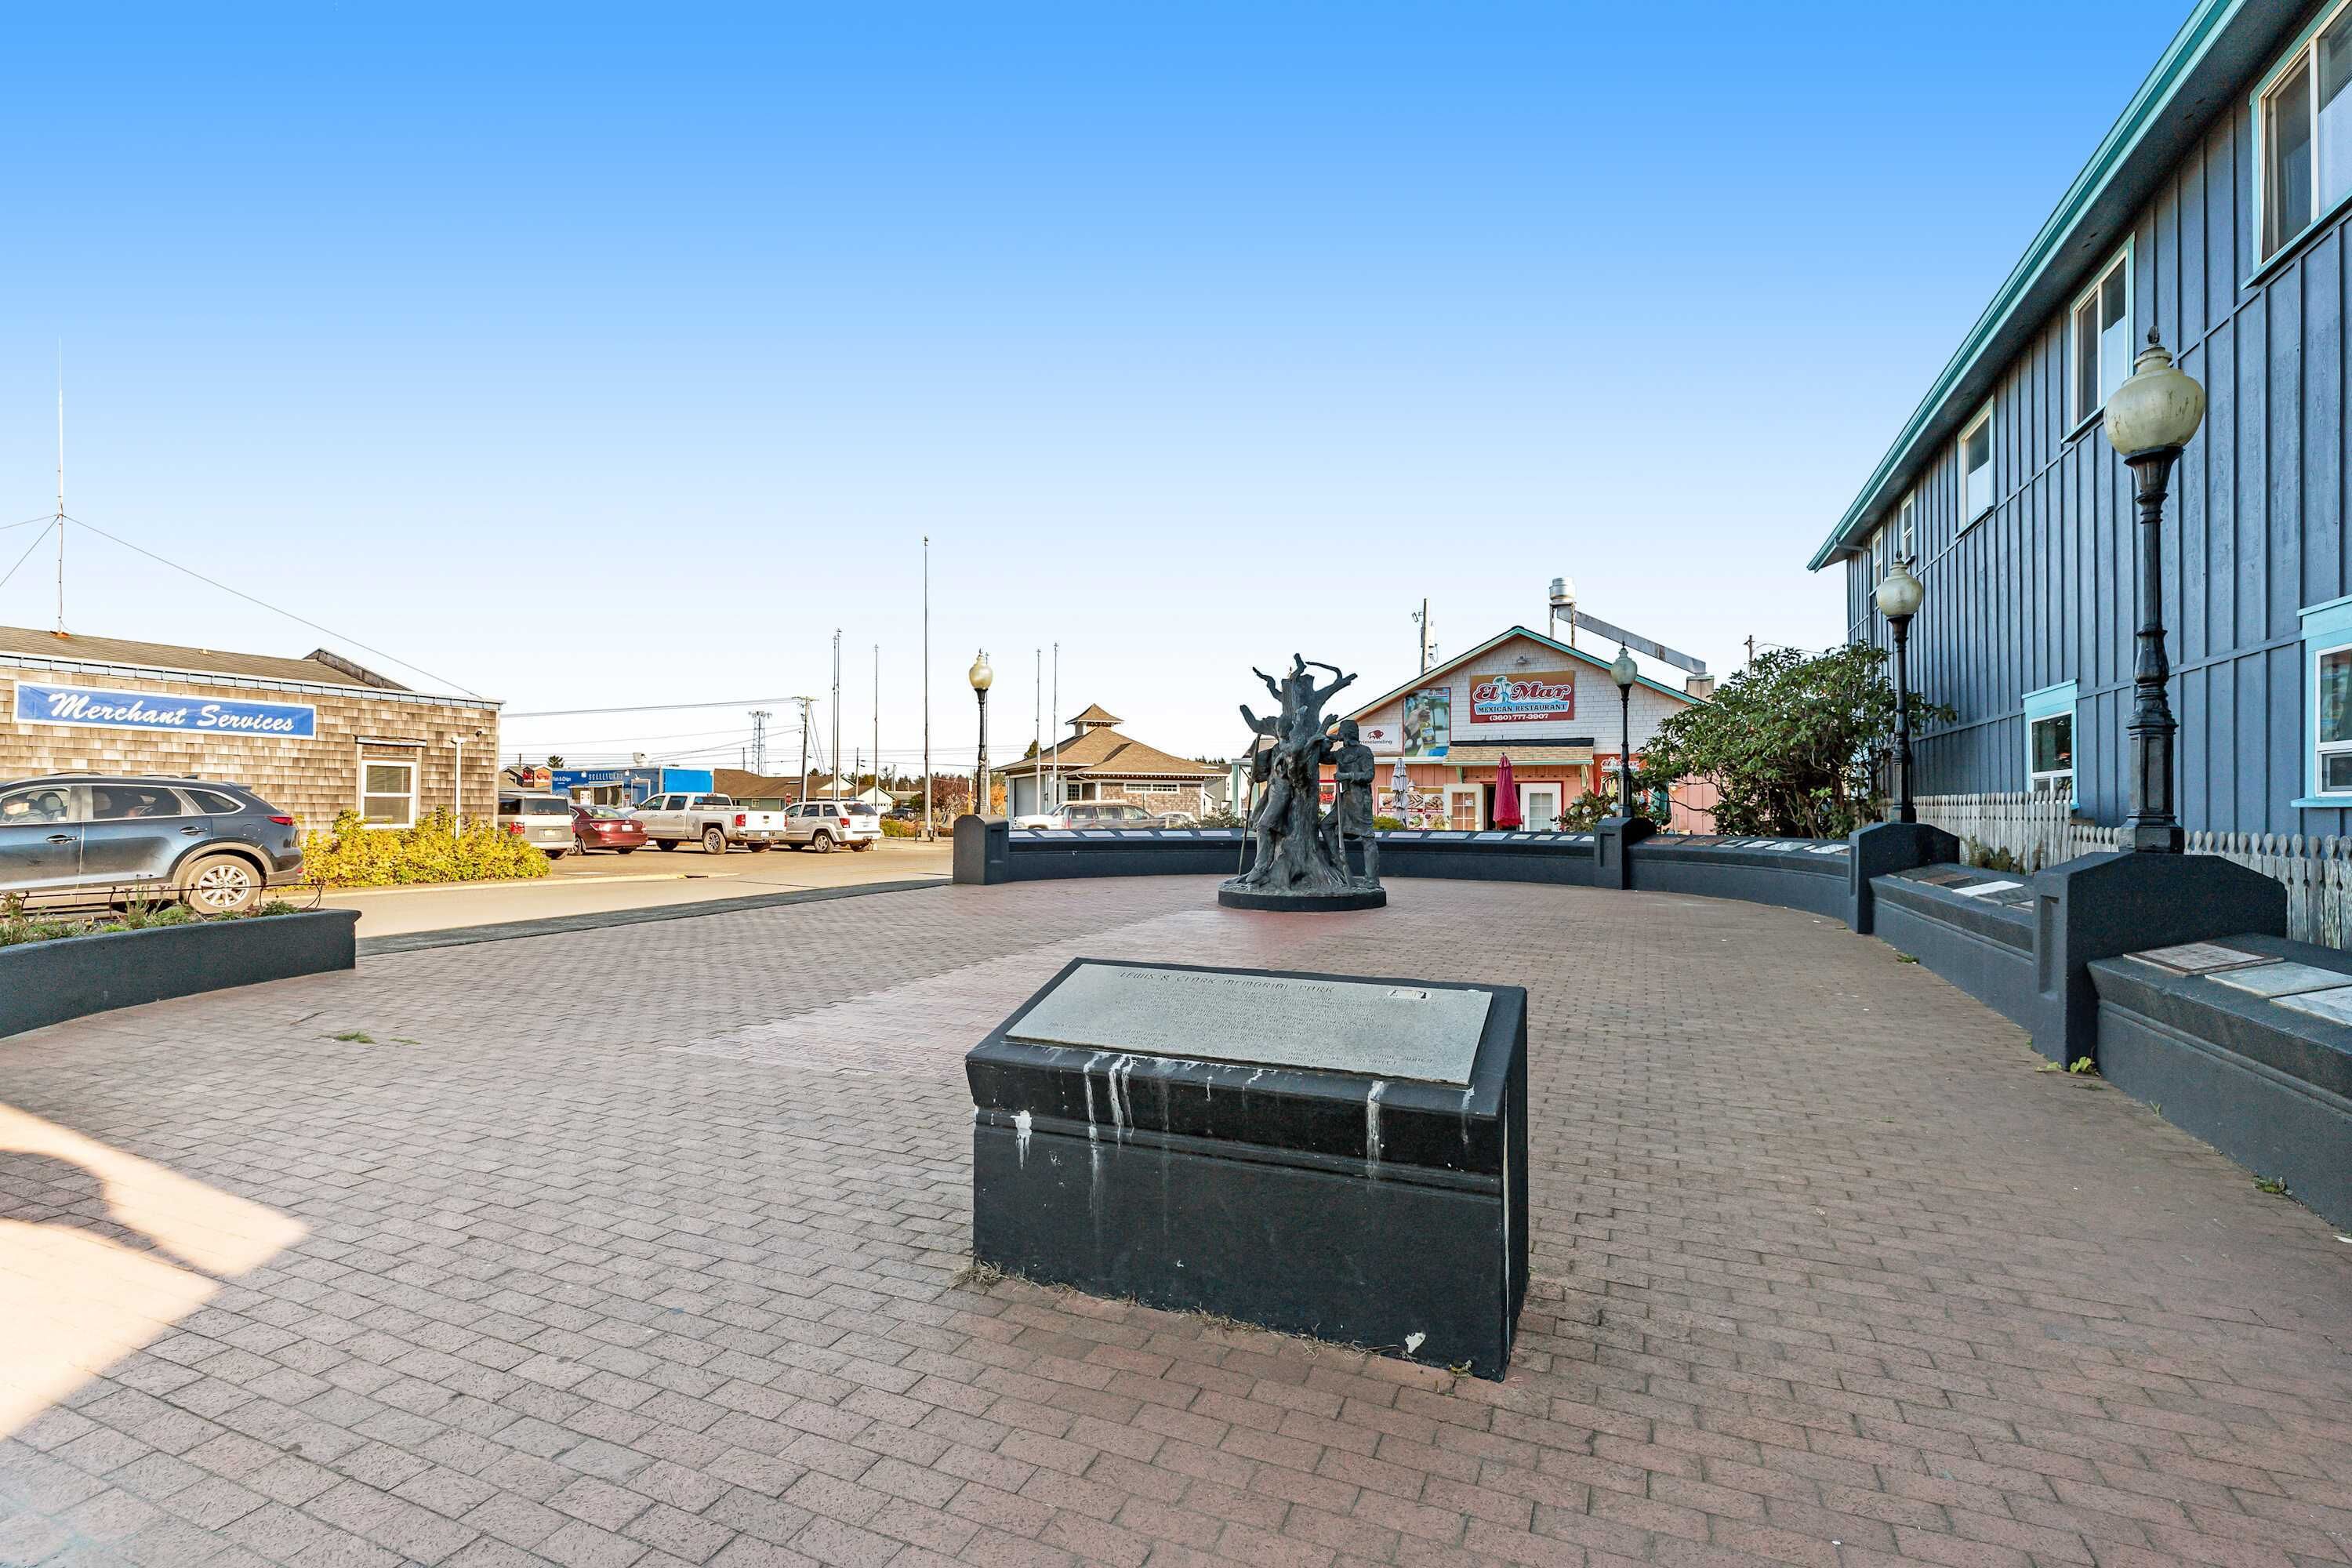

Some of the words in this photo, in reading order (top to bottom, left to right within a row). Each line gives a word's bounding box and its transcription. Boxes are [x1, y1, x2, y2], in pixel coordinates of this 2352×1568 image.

[1475, 684, 1498, 702] El
[1511, 682, 1570, 700] Mar
[48, 692, 187, 726] Merchant
[197, 705, 295, 731] Services
[1119, 971, 1154, 981] LEWIS
[1177, 975, 1218, 985] CLARK
[1223, 978, 1289, 991] MEMORIAL
[1298, 984, 1334, 994] PARK
